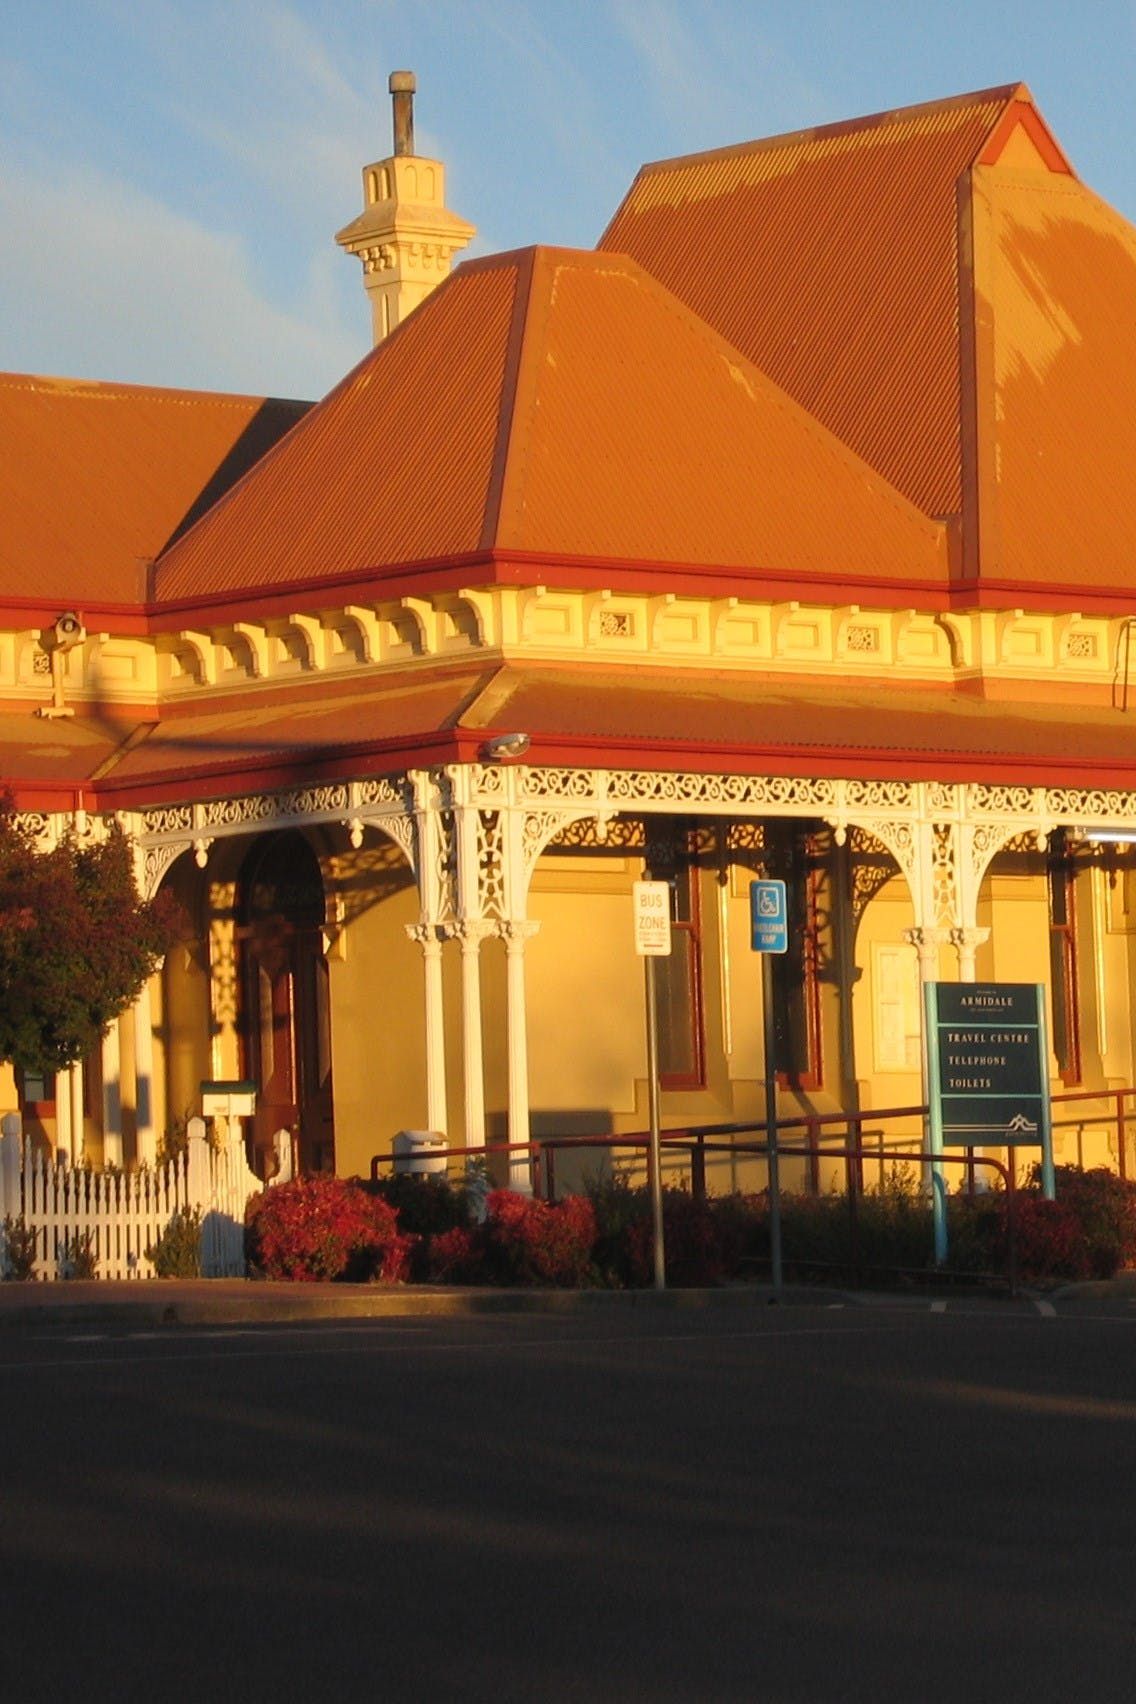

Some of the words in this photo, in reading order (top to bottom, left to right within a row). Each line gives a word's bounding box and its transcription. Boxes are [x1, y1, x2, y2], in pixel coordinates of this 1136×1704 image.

[640, 894, 663, 908] BUS
[639, 916, 667, 930] ZONE
[960, 997, 1013, 1006] ARMIDALE
[948, 1034, 986, 1043] TRAVEL
[990, 1034, 1029, 1043] CENTRE
[948, 1056, 1006, 1065] TELEPHONE
[950, 1078, 991, 1087] TOILETS
